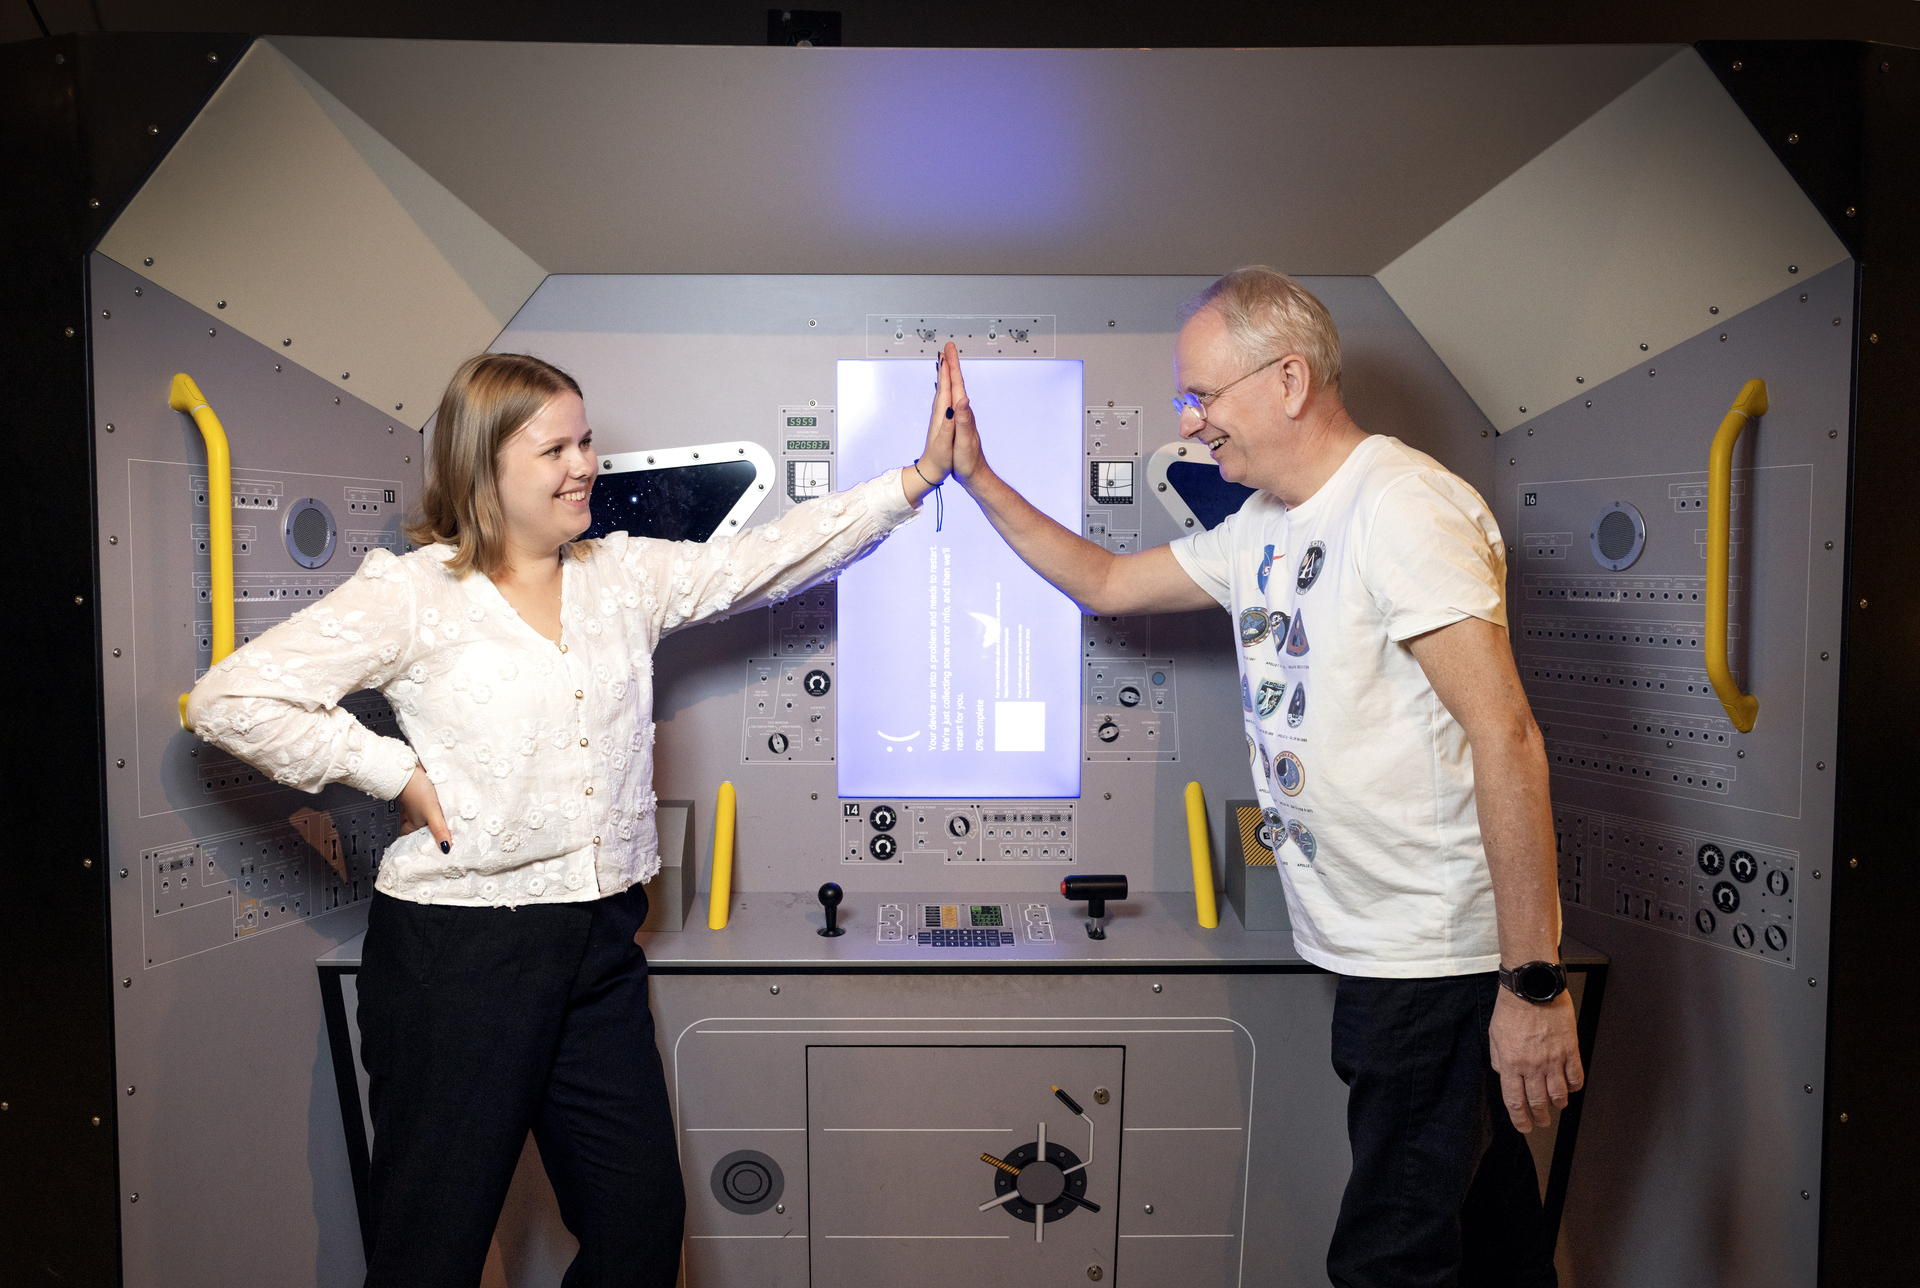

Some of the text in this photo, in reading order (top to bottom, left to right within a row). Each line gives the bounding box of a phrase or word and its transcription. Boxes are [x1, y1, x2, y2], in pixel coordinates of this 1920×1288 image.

[385, 492, 393, 501] 11
[1526, 495, 1535, 504] 16
[942, 548, 950, 566] we'll
[930, 575, 937, 584] to
[942, 568, 950, 586] then
[929, 585, 937, 610] needs
[942, 588, 950, 604] and
[929, 612, 937, 627] and
[942, 606, 952, 623] info,
[928, 628, 938, 662] problem
[942, 671, 952, 709] collecting
[1264, 680, 1285, 688] APOLLO
[957, 692, 966, 710] you.
[928, 705, 936, 730] device
[942, 711, 952, 726] just
[955, 712, 964, 724] for
[976, 700, 986, 751] 0% complete
[928, 732, 936, 751] Your
[942, 727, 950, 751] We're
[1275, 752, 1294, 763] APOLLO
[390, 801, 394, 811] 8
[845, 805, 858, 815] 14
